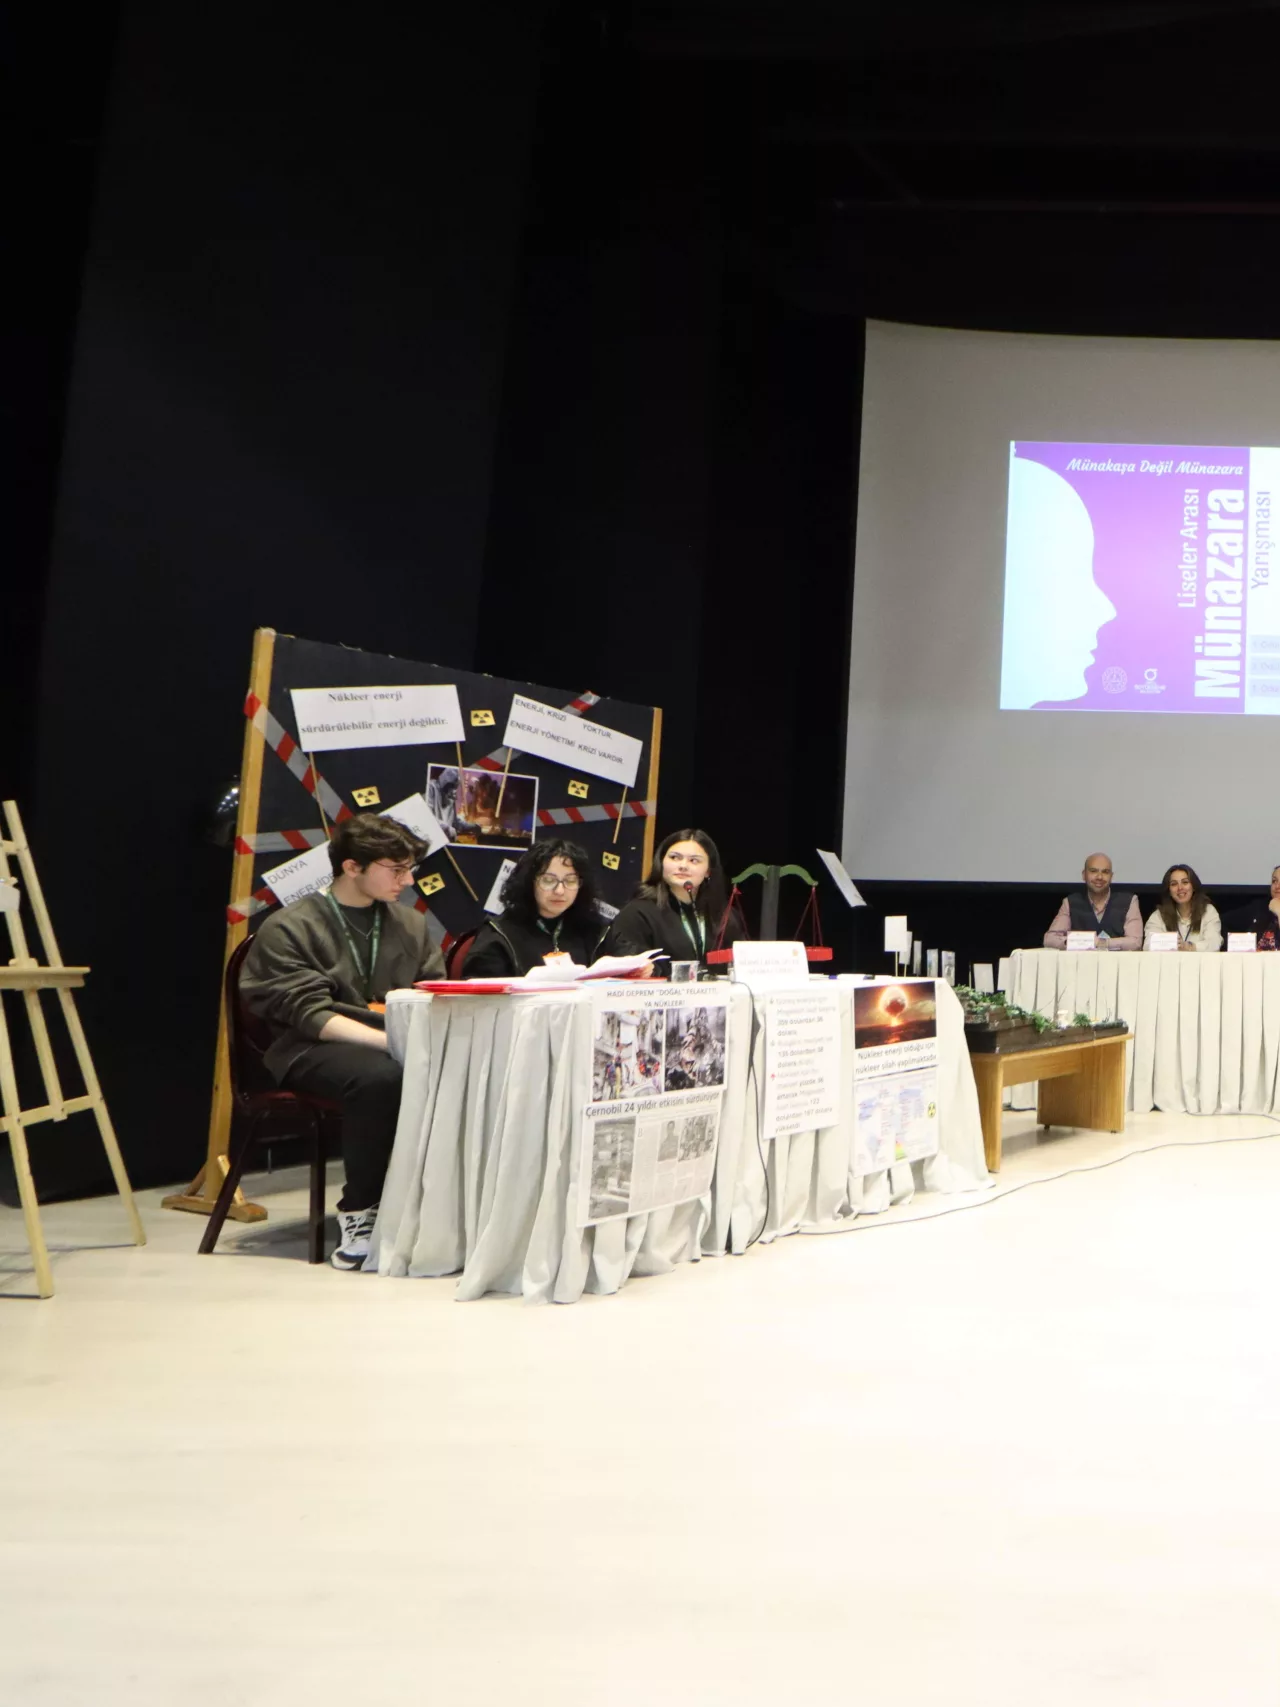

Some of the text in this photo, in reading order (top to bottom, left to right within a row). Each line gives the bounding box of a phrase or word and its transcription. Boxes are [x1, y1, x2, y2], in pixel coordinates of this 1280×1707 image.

[1066, 458, 1244, 476] Münakaşa Değil Münazara
[1177, 488, 1199, 607] Liseler Arası
[1251, 491, 1275, 590] Yarışması
[1194, 488, 1245, 698] Münazara
[328, 691, 402, 703] Nükleer enerji
[301, 717, 449, 734] sürdürülebilir enerji değildir.
[267, 859, 309, 885] DÜNYA
[626, 989, 655, 997] DEPREM
[585, 1103, 622, 1118] Çernobil
[624, 1103, 634, 1112] 24
